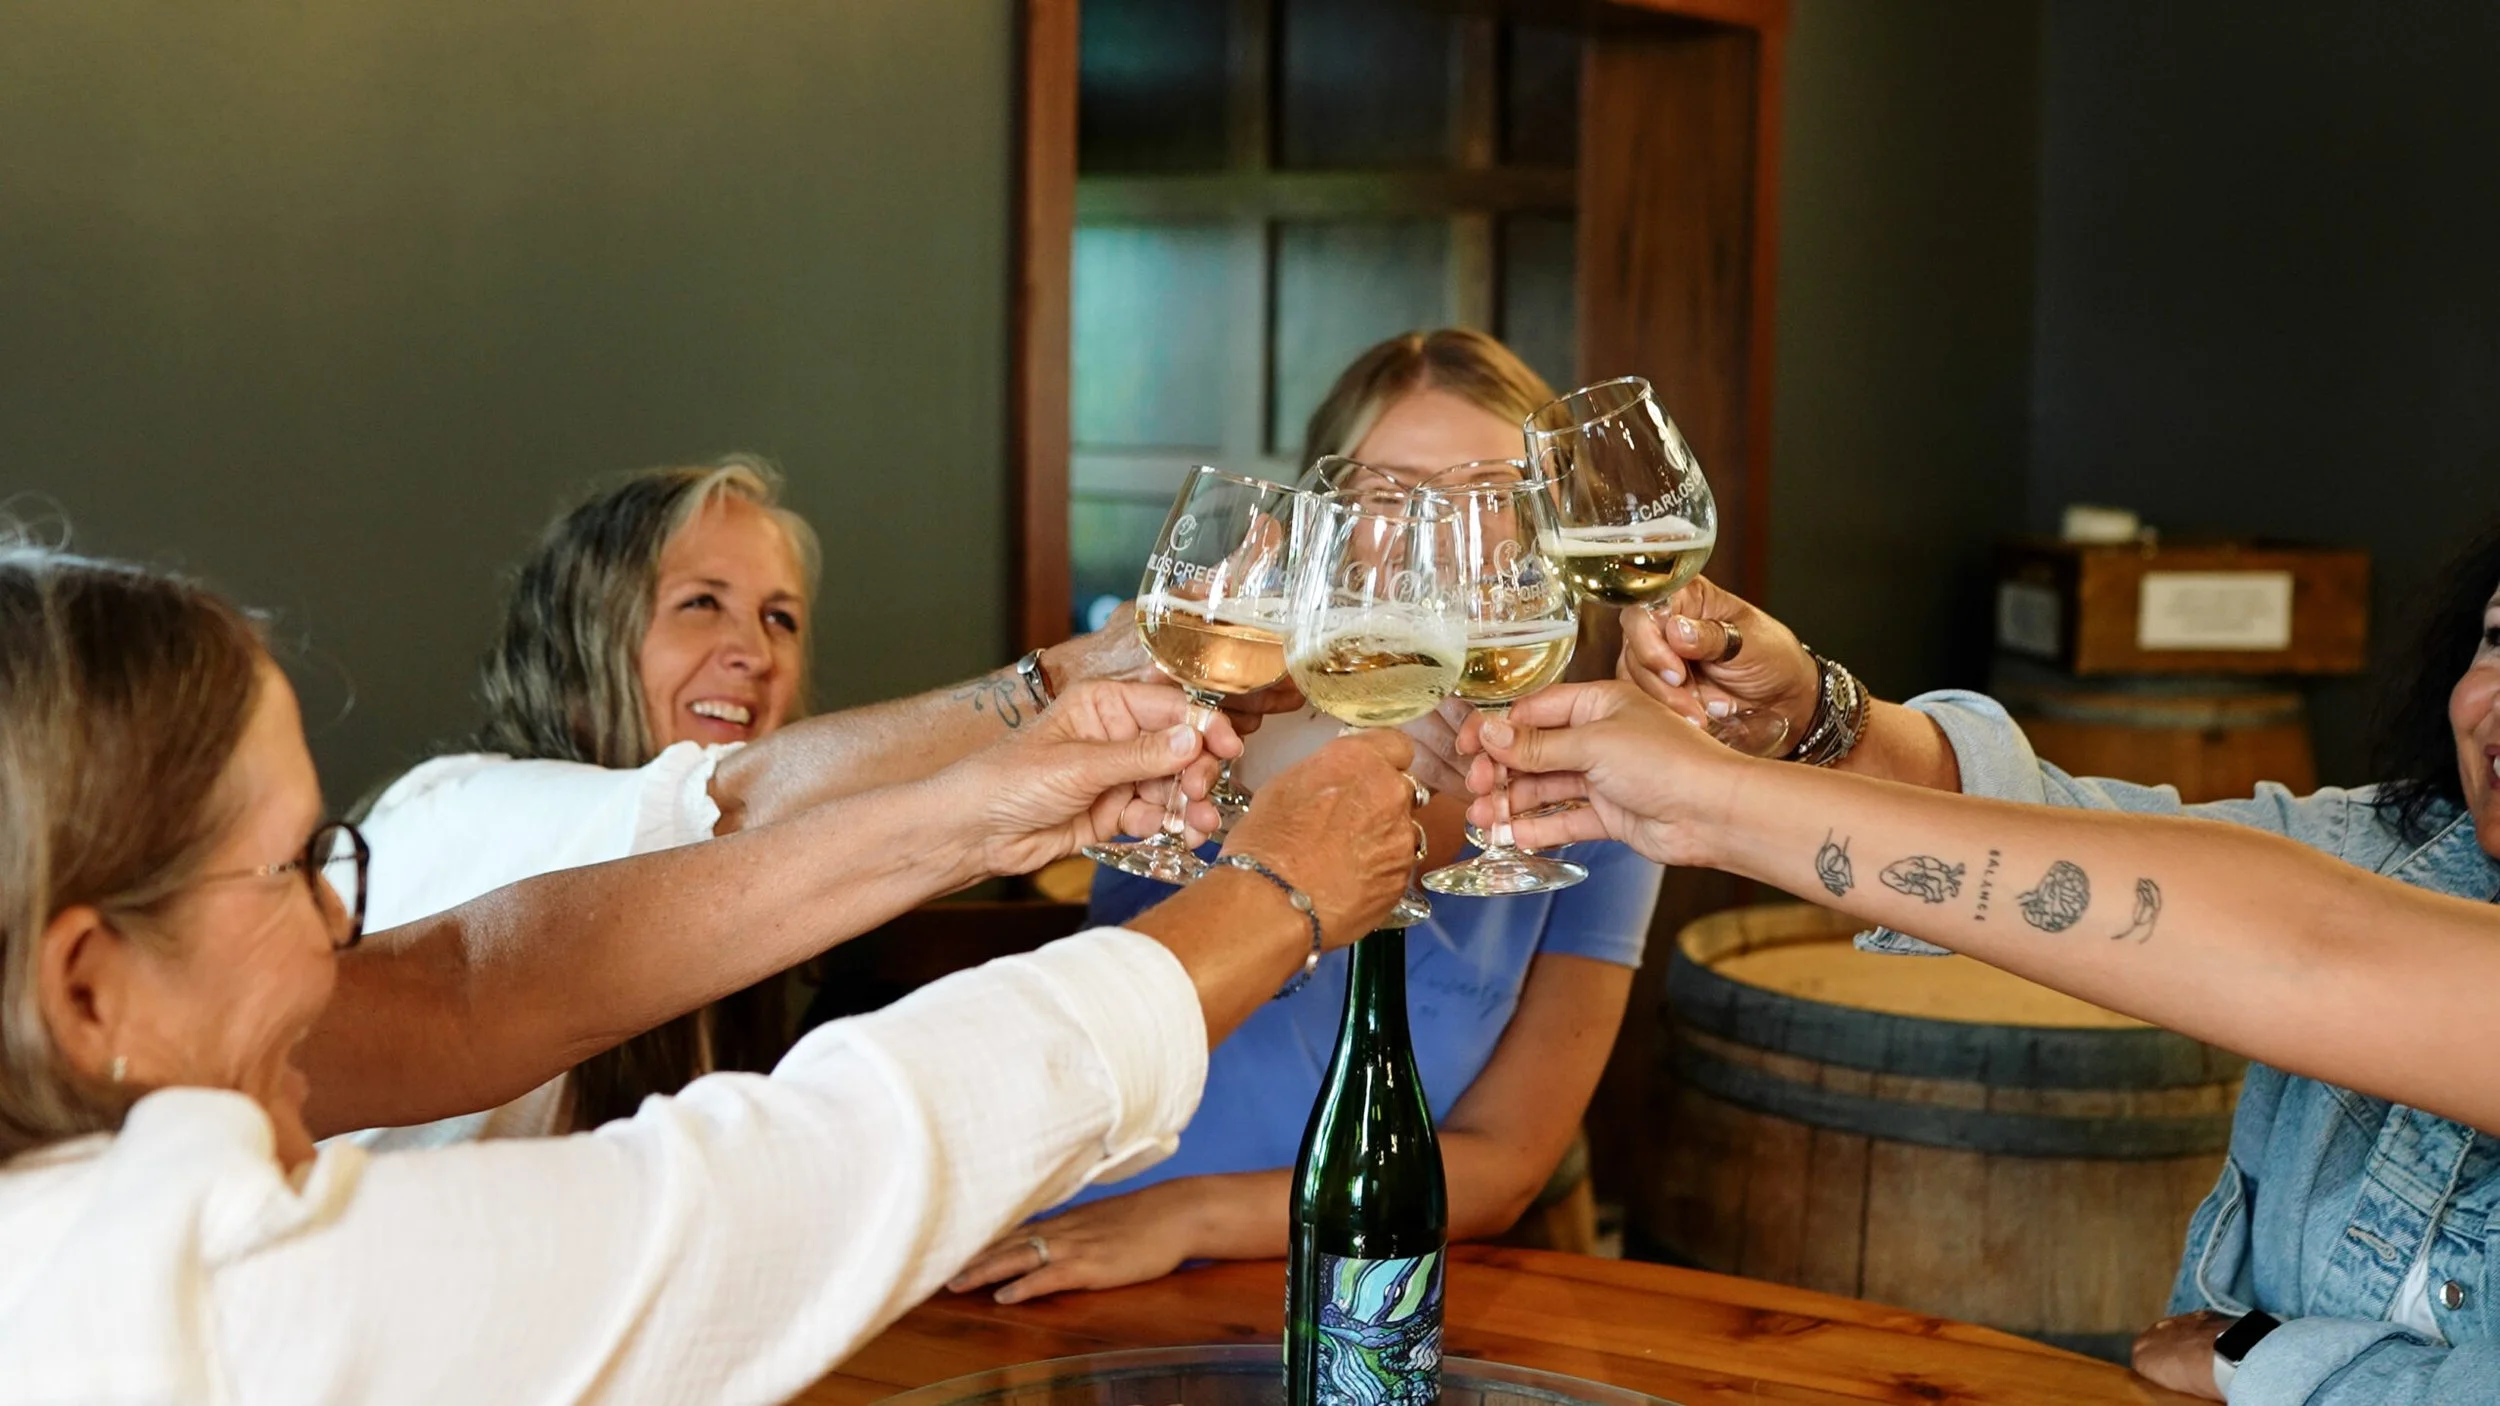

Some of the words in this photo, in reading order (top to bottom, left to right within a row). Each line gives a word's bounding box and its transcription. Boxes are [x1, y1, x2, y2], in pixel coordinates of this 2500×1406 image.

[1639, 477, 1695, 521] CARLOS
[1174, 560, 1228, 587] CREE
[1973, 848, 2001, 922] BALANCE
